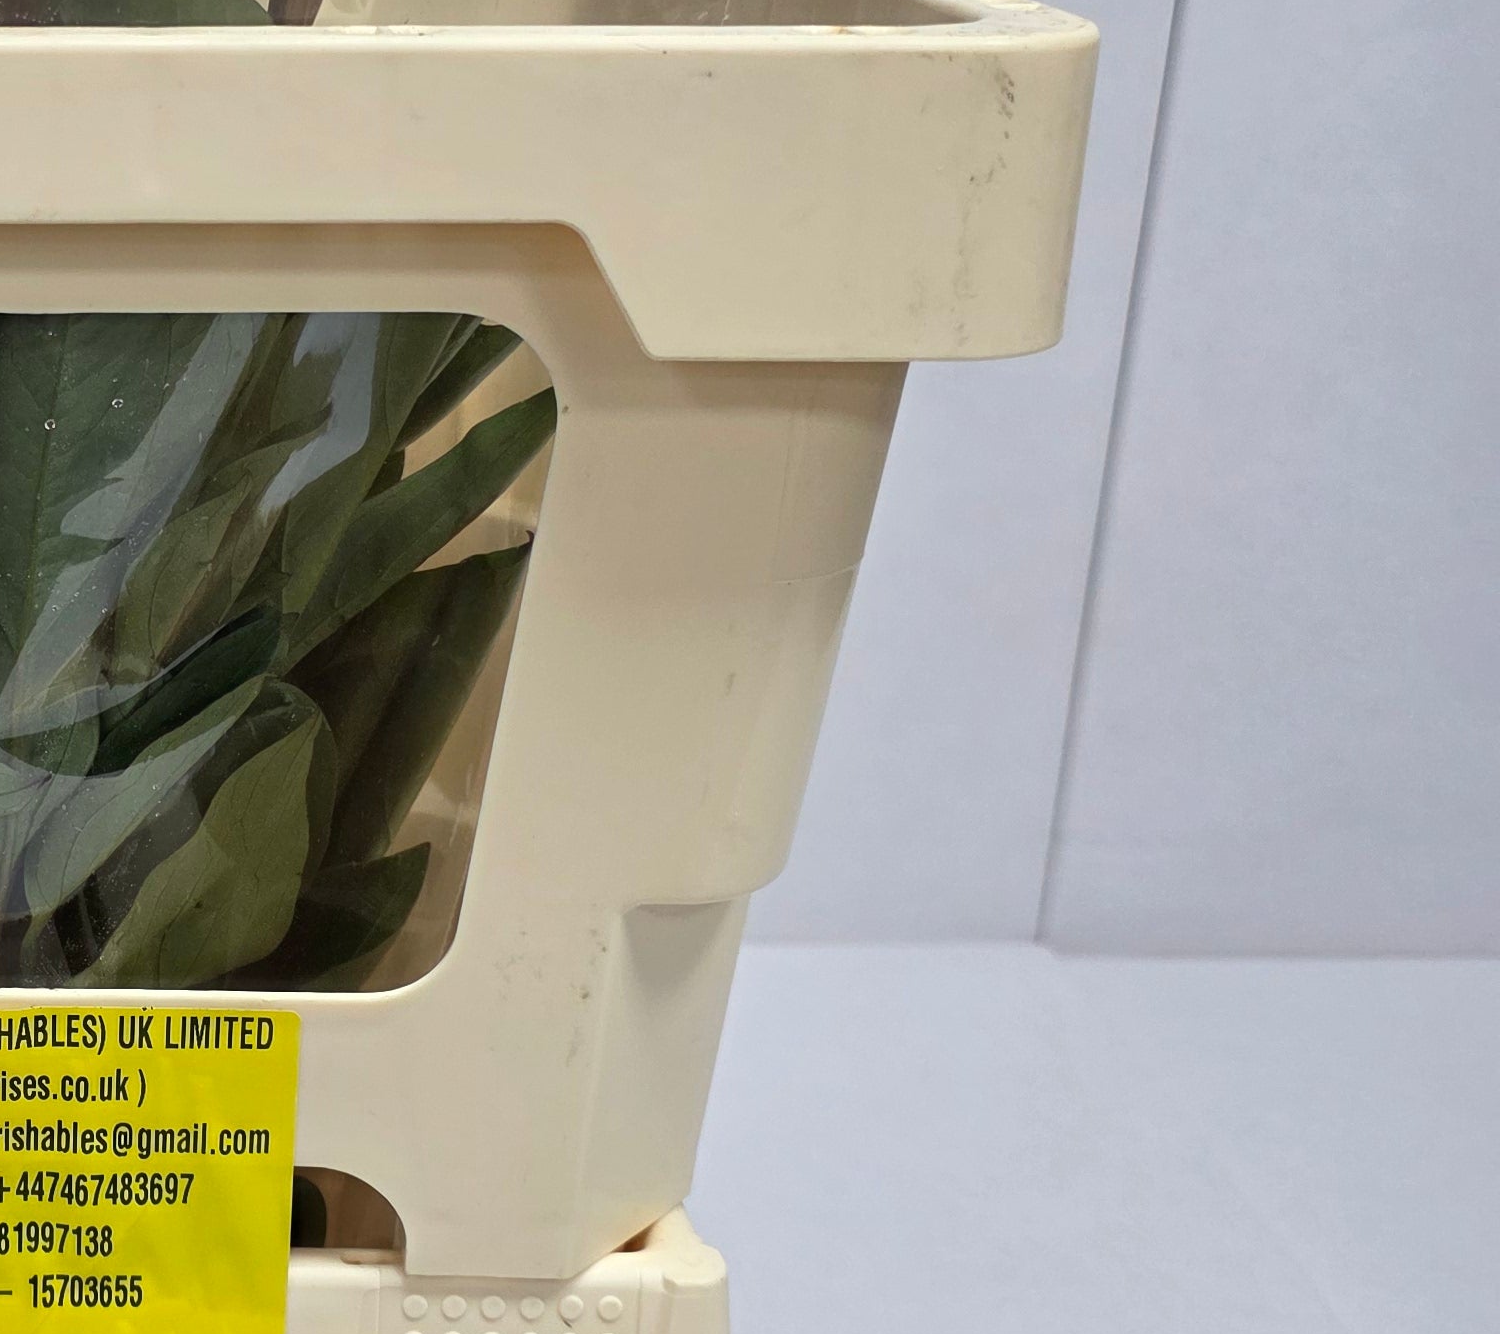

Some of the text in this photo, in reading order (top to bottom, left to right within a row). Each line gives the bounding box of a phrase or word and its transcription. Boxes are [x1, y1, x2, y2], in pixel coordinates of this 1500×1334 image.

[118, 1015, 154, 1050] UK
[165, 1016, 274, 1050] LIMITED
[28, 1274, 143, 1308] 15703655
